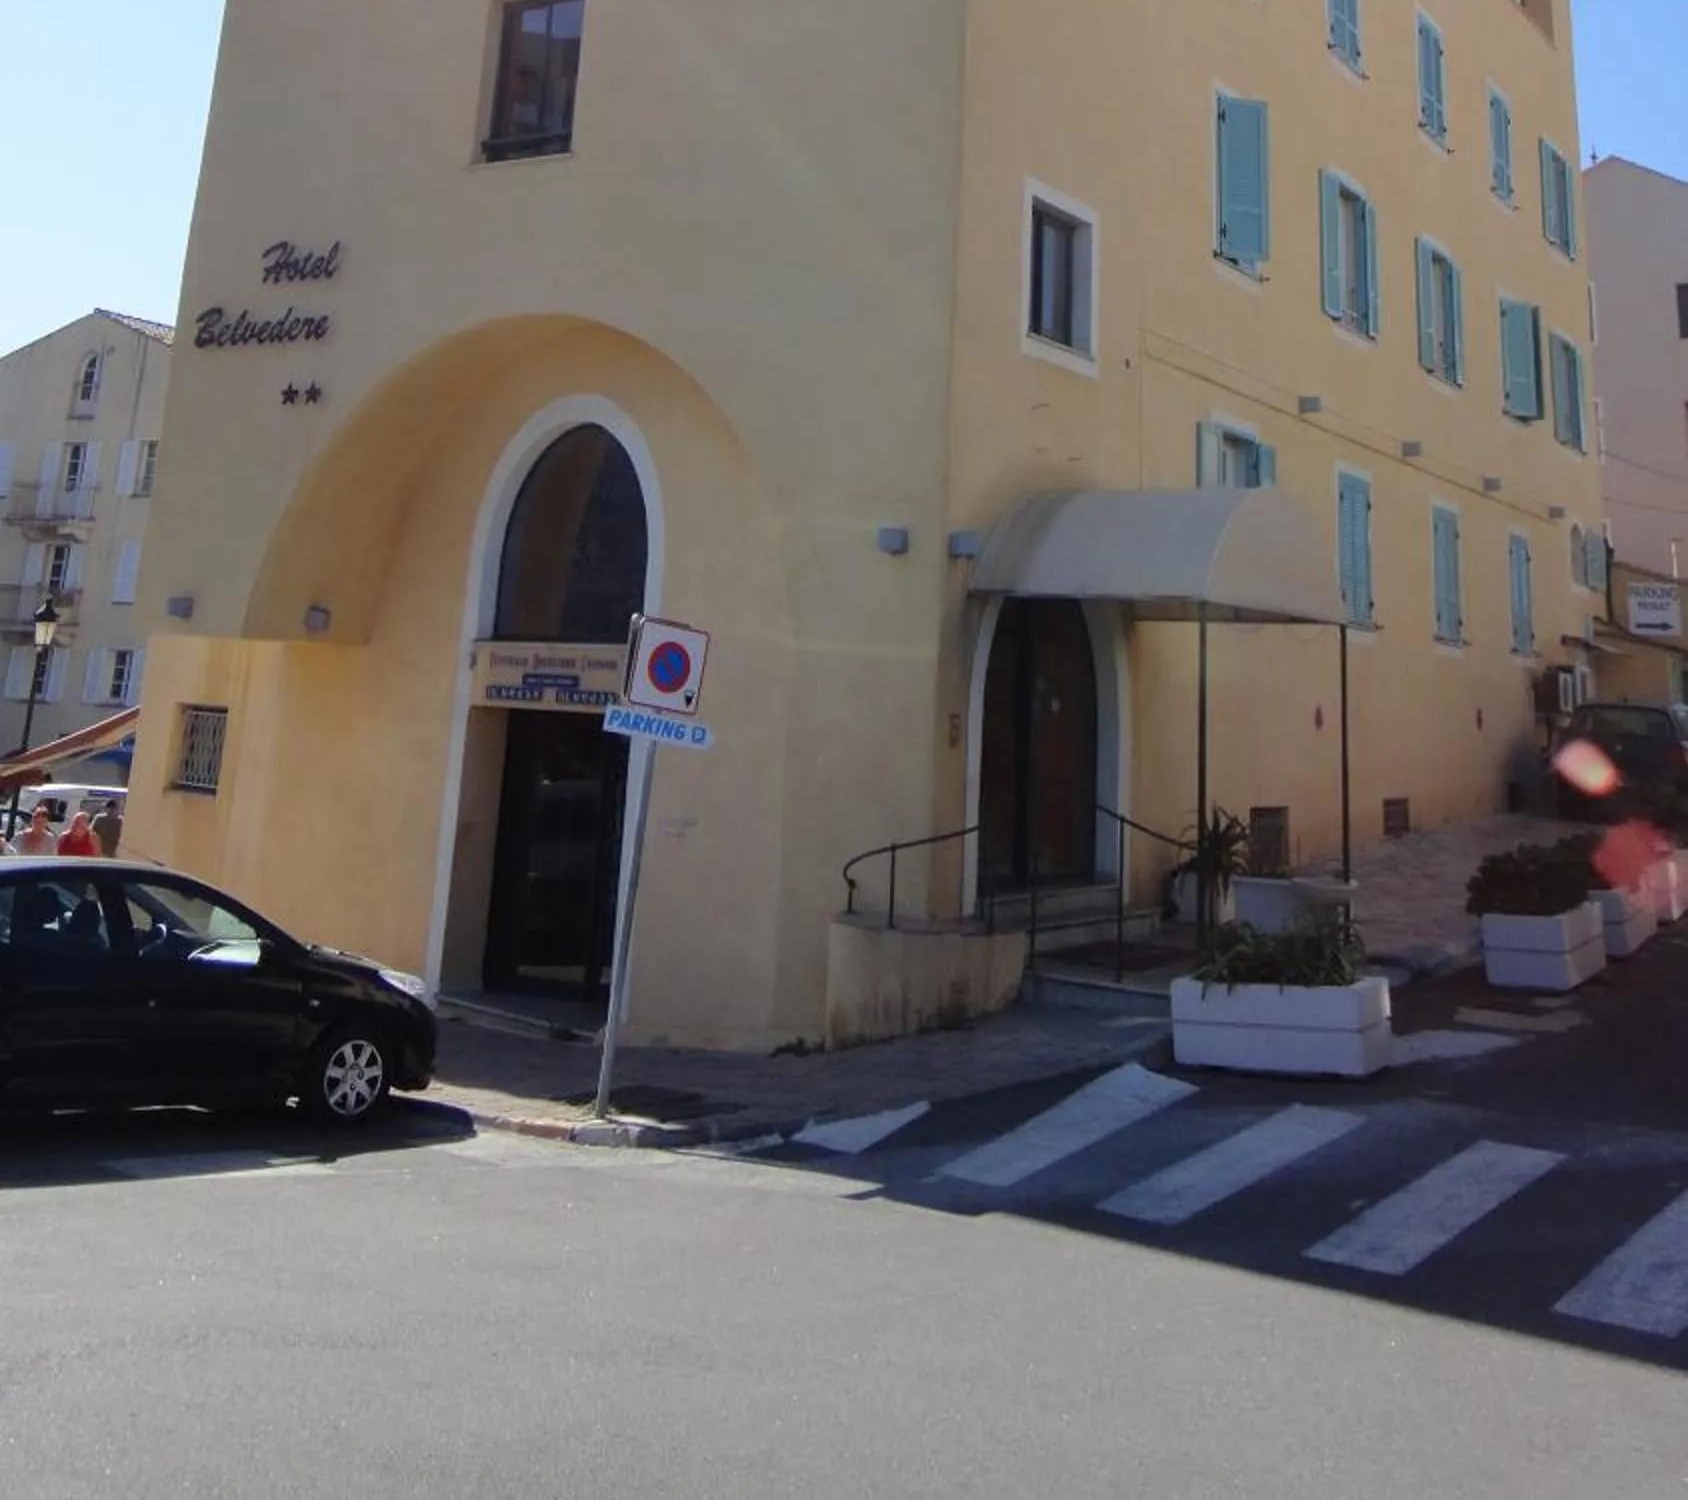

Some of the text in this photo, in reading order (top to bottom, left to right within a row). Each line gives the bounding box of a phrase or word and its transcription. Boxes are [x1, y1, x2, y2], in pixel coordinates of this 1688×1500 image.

[262, 240, 340, 284] Hotel
[194, 306, 330, 348] Belvedere
[606, 709, 686, 741] PARKING
